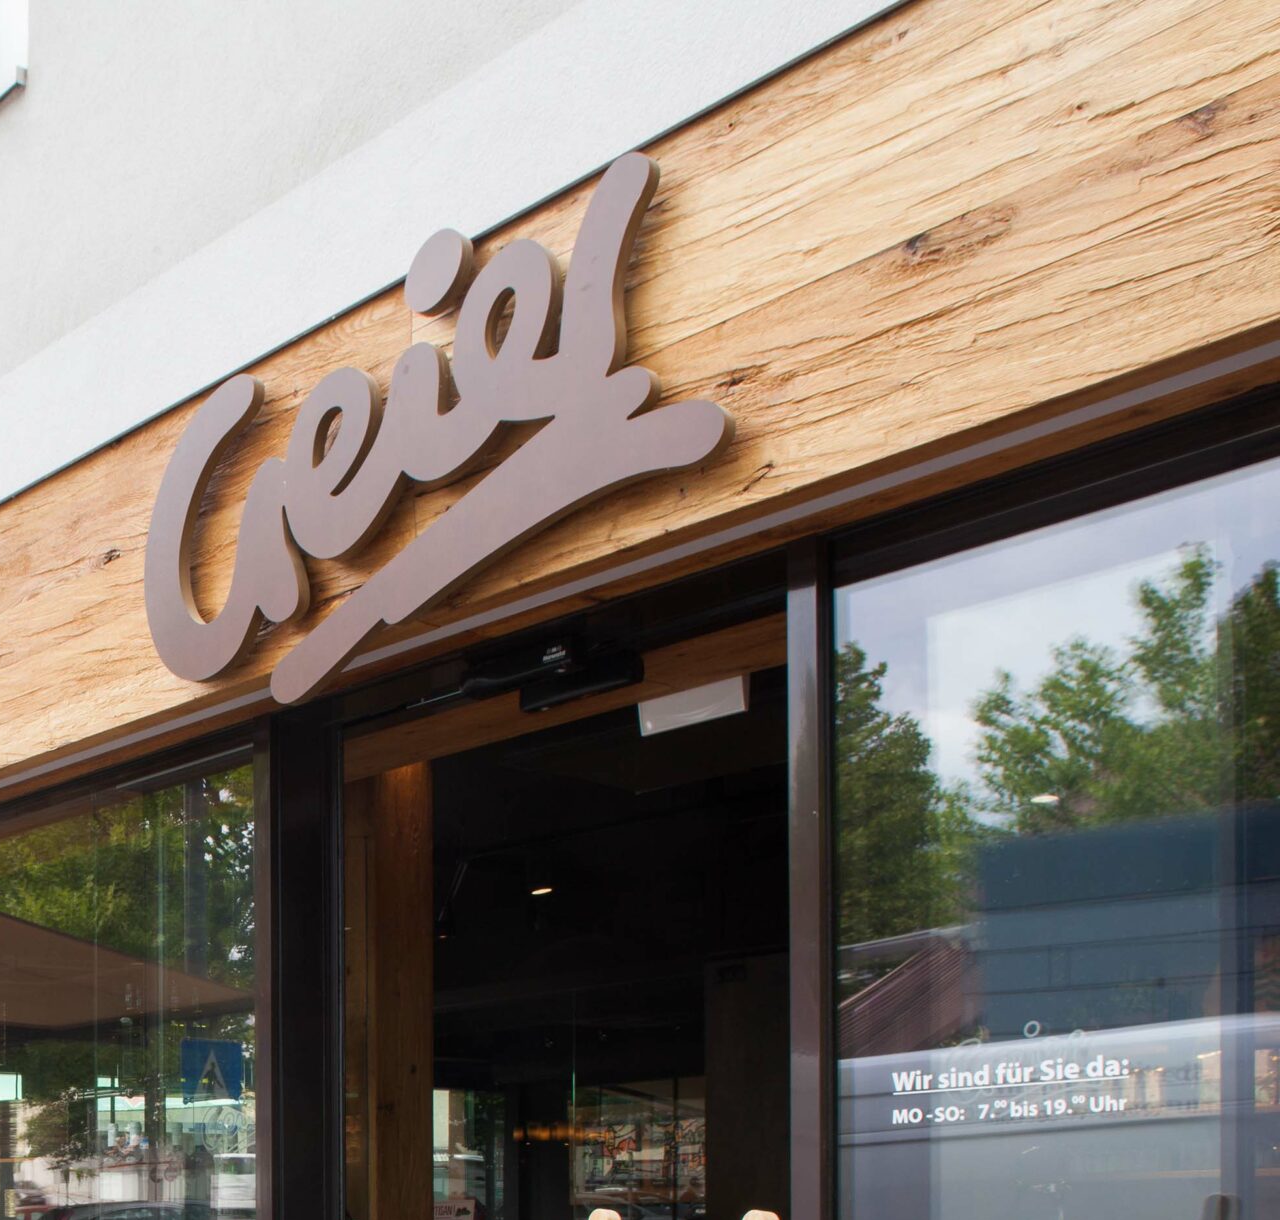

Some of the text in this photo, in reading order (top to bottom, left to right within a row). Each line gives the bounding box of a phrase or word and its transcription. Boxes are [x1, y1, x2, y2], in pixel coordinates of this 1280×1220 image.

[892, 1054, 1130, 1092] Wir sind für Sie da:
[892, 1107, 923, 1124] MO
[1009, 1099, 1038, 1118] bis
[1090, 1095, 1128, 1113] Uhr
